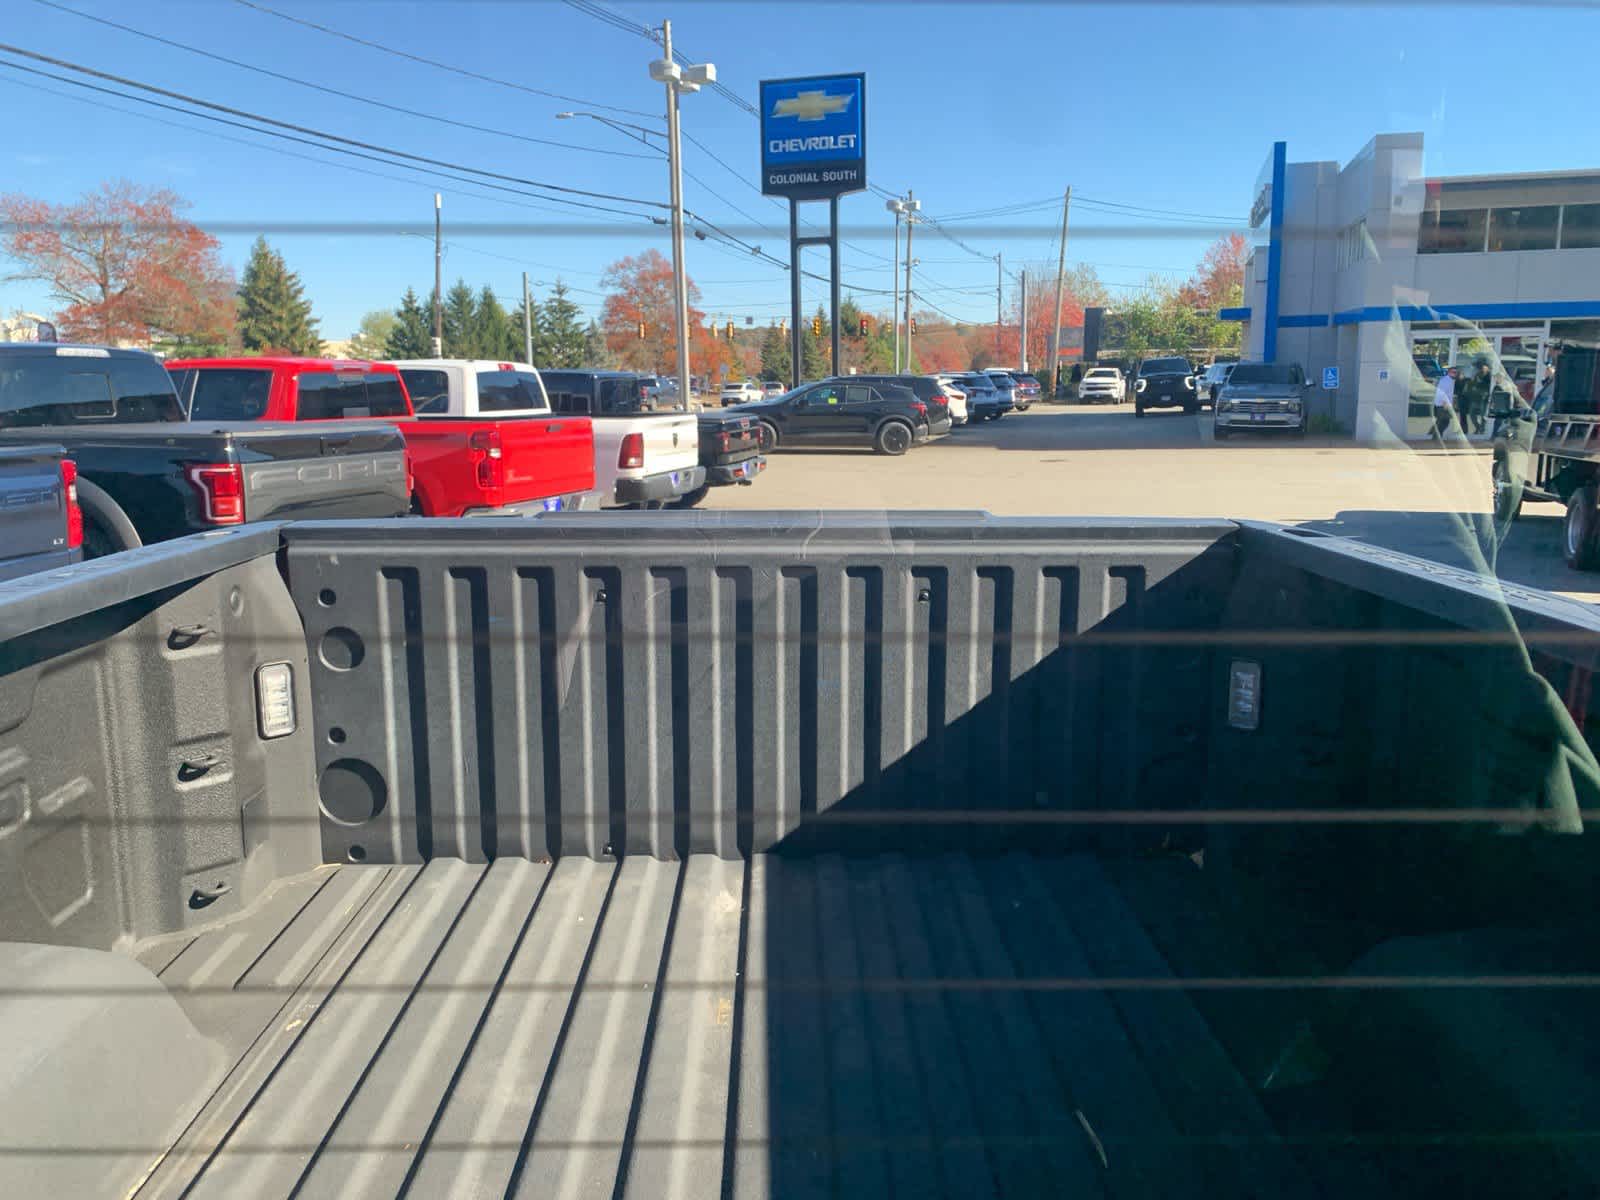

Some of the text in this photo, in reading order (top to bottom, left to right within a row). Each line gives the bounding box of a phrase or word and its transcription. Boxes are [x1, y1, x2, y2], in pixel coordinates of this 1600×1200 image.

[769, 134, 857, 153] CHEVROLET
[769, 169, 857, 185] COLONIAL SOUTH
[250, 456, 402, 491] FORD
[53, 537, 65, 545] LT
